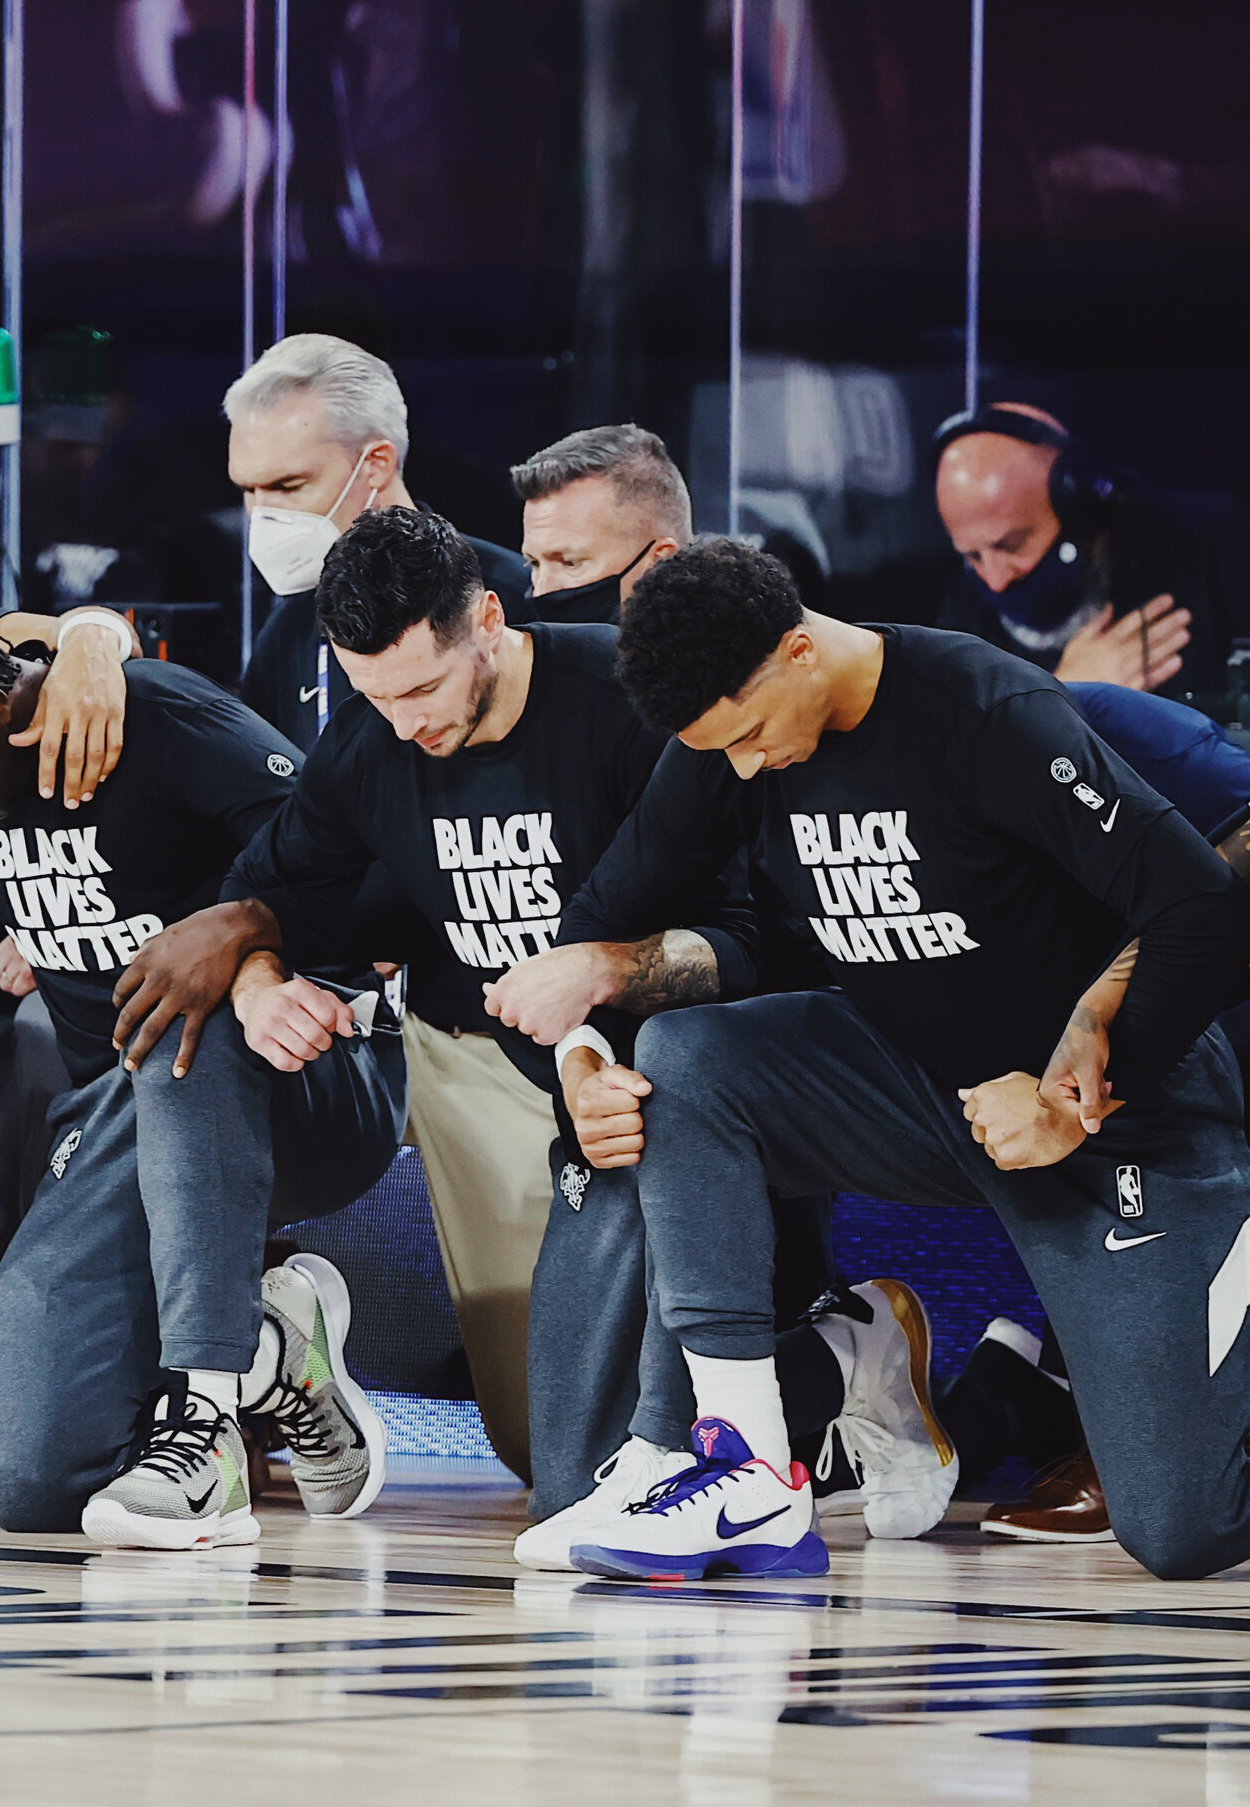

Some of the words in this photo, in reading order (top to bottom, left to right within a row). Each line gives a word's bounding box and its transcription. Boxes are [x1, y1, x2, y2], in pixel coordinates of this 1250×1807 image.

[433, 812, 563, 869] BLACK
[790, 811, 920, 865] BLACK
[5, 876, 116, 928] LIVES
[452, 866, 561, 921] LIVES
[812, 864, 920, 916] LIVES
[444, 917, 561, 968] MATT
[808, 912, 981, 963] MATTER
